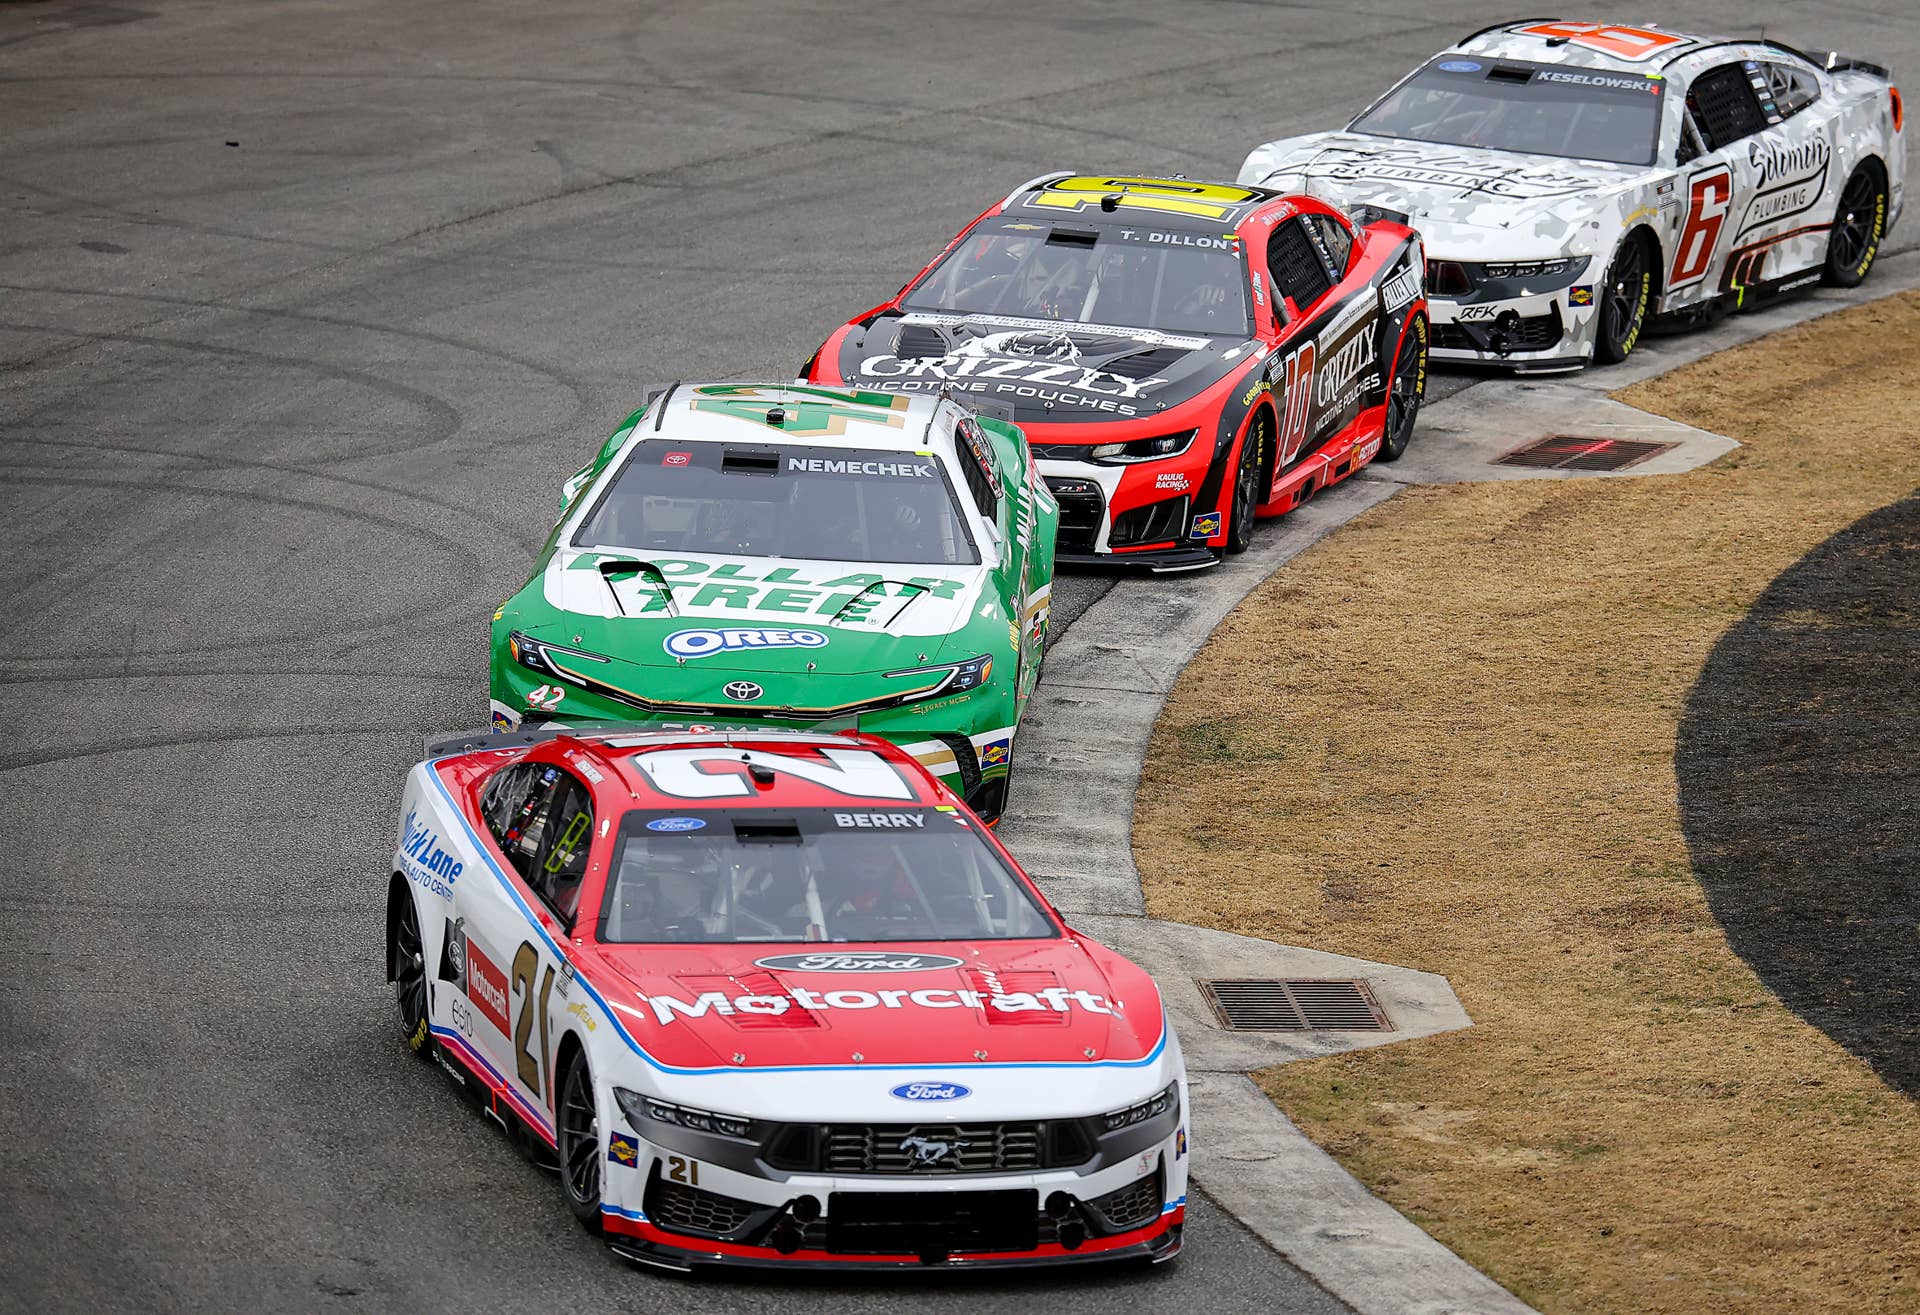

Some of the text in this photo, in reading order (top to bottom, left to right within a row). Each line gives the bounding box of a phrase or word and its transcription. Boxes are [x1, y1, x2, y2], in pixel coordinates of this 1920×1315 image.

[1537, 71, 1652, 92] KESELOWSKI
[1034, 176, 1256, 218] 10
[1752, 188, 1807, 220] PLUMBING
[1119, 230, 1229, 250] T. DILLON
[1668, 171, 1731, 287] 6
[1460, 304, 1499, 320] RFK
[859, 353, 1170, 398] GRIZZLY
[1317, 318, 1380, 407] GRIZZLY
[690, 384, 911, 437] 42
[854, 381, 1138, 417] NICOTINE POUCHES
[1281, 340, 1316, 468] 10
[1314, 372, 1381, 433] NICOTINE POUCHES
[787, 457, 933, 478] NEMECHEK
[1156, 473, 1184, 481] KAULIG
[1154, 481, 1185, 490] RACING
[567, 552, 968, 600] DOLLAR
[637, 581, 885, 625] TREE
[669, 629, 826, 655] OREO
[527, 684, 566, 712] 42
[654, 818, 698, 831] Ford
[833, 813, 925, 829] BERRY
[417, 834, 463, 884] Lane
[410, 866, 431, 888] AUTO
[795, 954, 925, 971] Ford
[470, 957, 508, 1022] Motorcraft
[647, 987, 1113, 1026] Motorcraft
[511, 940, 555, 1115] 21
[904, 1083, 957, 1100] Ford
[669, 1155, 699, 1185] 21
